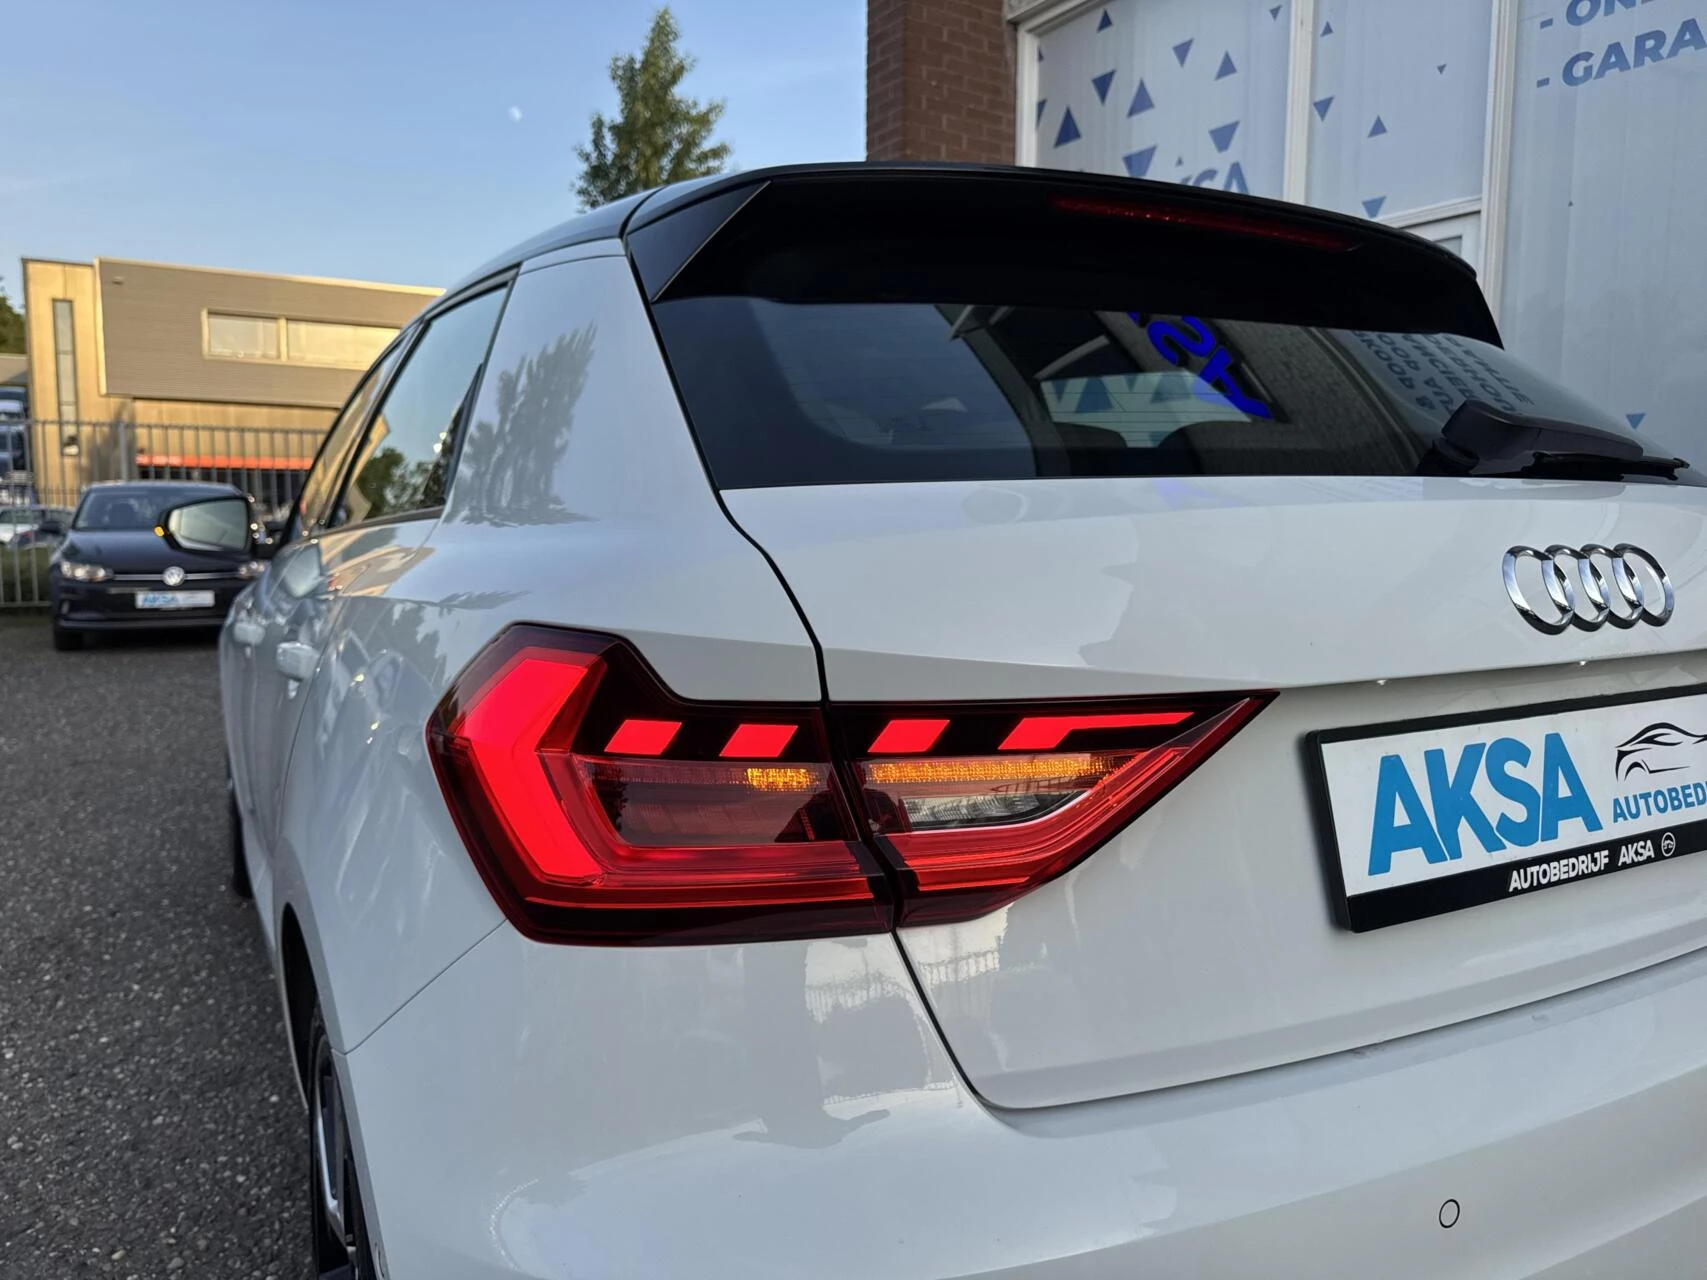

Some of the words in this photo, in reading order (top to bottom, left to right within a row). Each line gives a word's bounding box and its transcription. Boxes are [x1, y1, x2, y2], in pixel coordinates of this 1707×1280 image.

[1566, 0, 1655, 27] ON
[1562, 18, 1707, 87] GARA
[1368, 732, 1603, 876] AKSA
[1612, 781, 1707, 823] AUTOBED
[1508, 850, 1609, 892] AUTOBEDRIJF
[1618, 839, 1655, 866] AKSA
